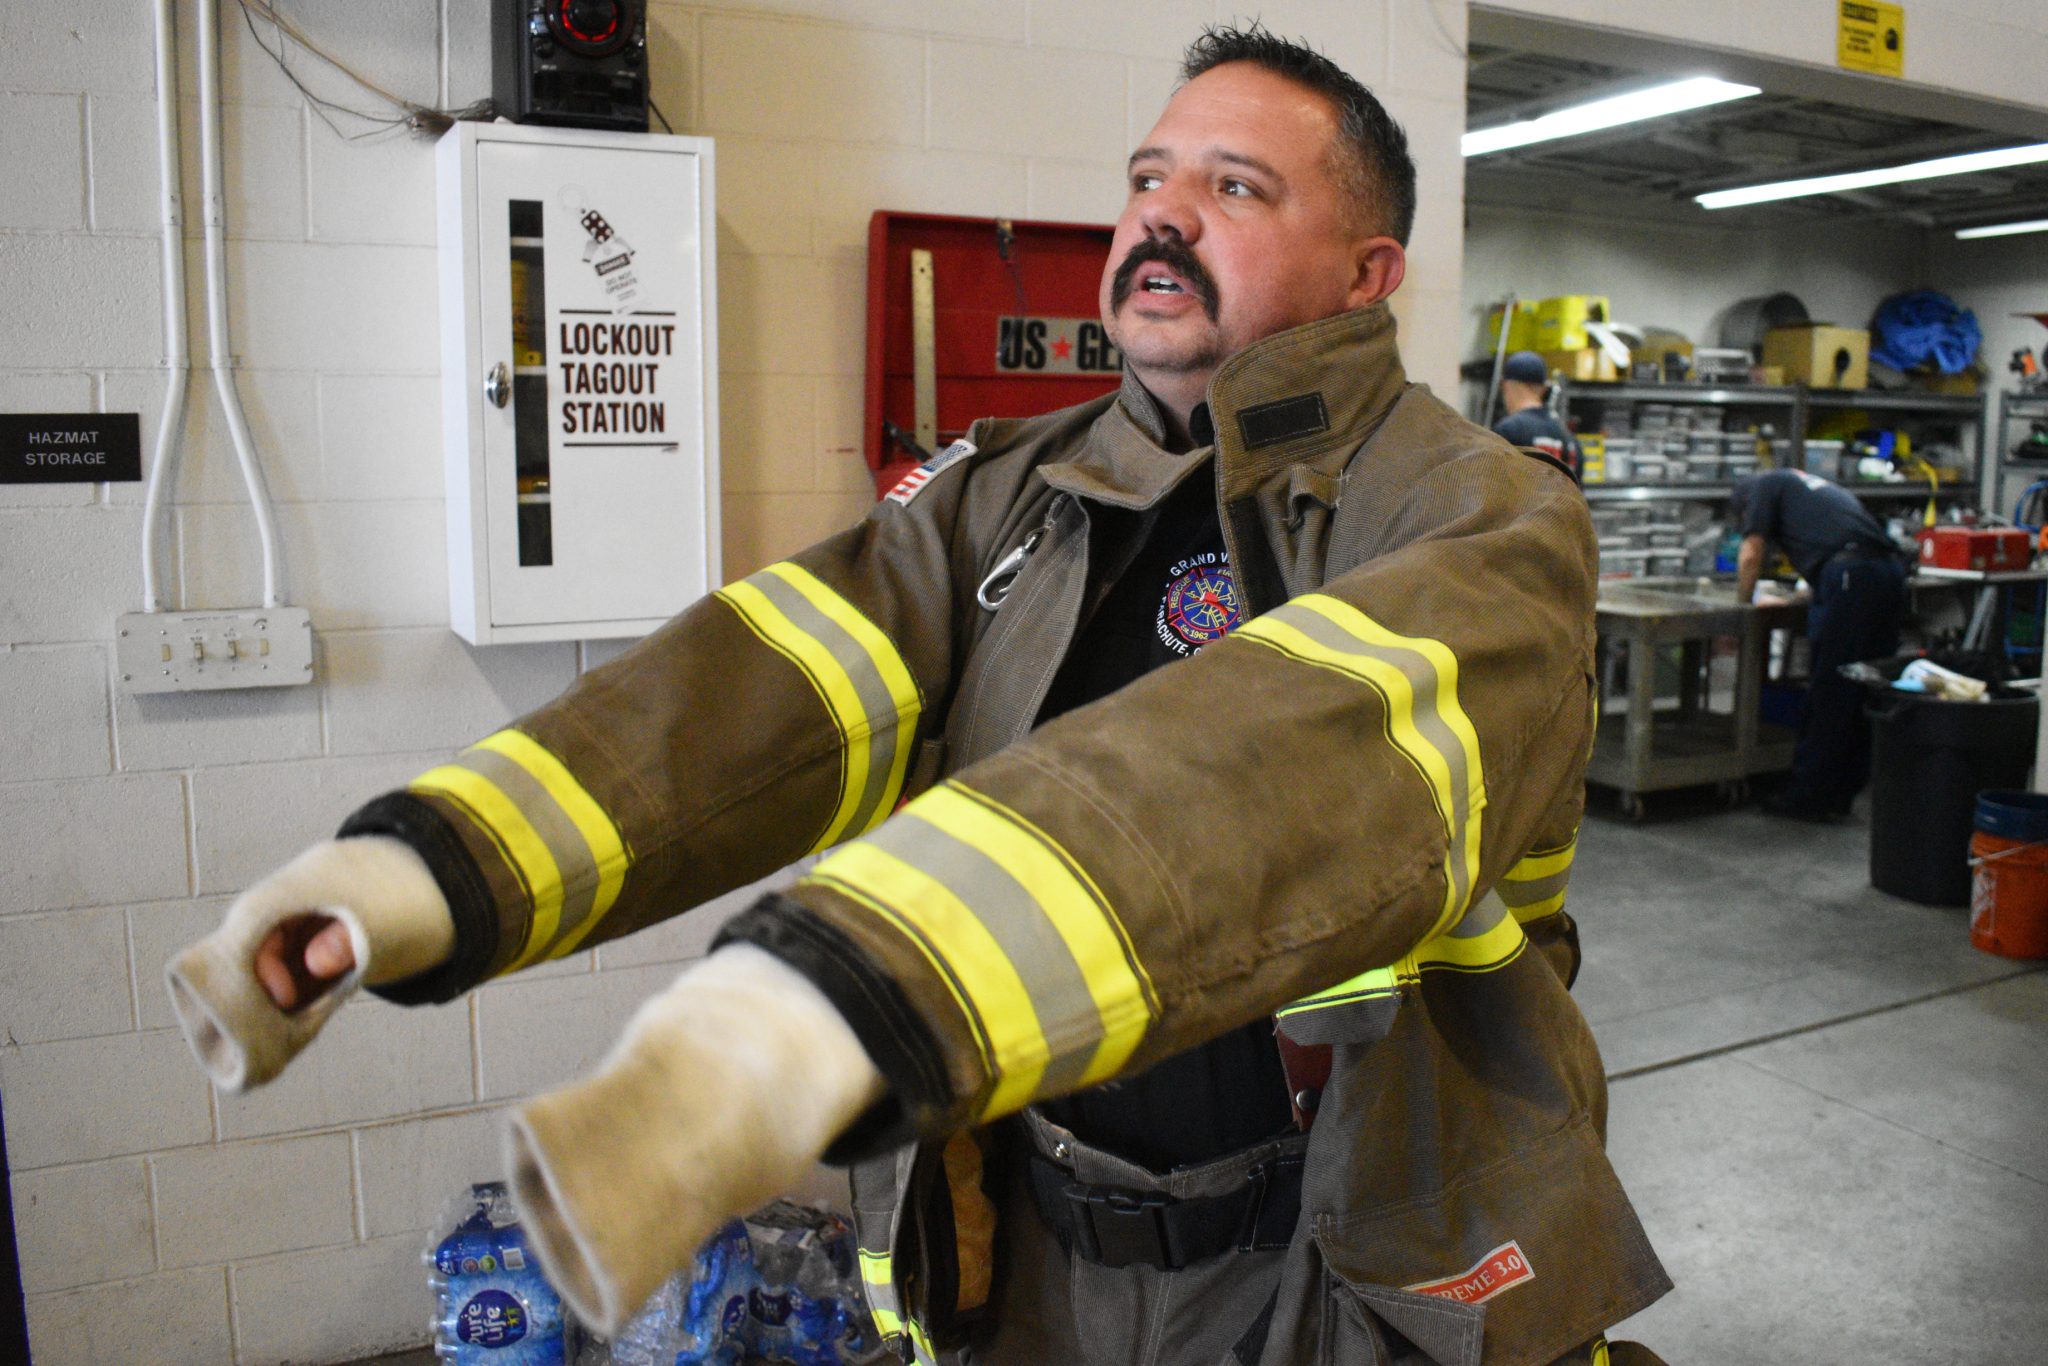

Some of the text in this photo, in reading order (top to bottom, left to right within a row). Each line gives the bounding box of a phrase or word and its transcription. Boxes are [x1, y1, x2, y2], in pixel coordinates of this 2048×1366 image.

[560, 323, 675, 355] LOCKOUT
[1001, 318, 1123, 371] US GE
[560, 362, 659, 394] TAGOUT
[562, 401, 665, 434] STATION
[29, 431, 99, 445] HAZMAT
[25, 452, 106, 466] STORAGE
[1170, 552, 1216, 576] GRAND
[1170, 576, 1192, 609] RESCUE
[1190, 630, 1209, 640] 1962
[1493, 1254, 1522, 1277] 3.0
[483, 1306, 508, 1342] Life
